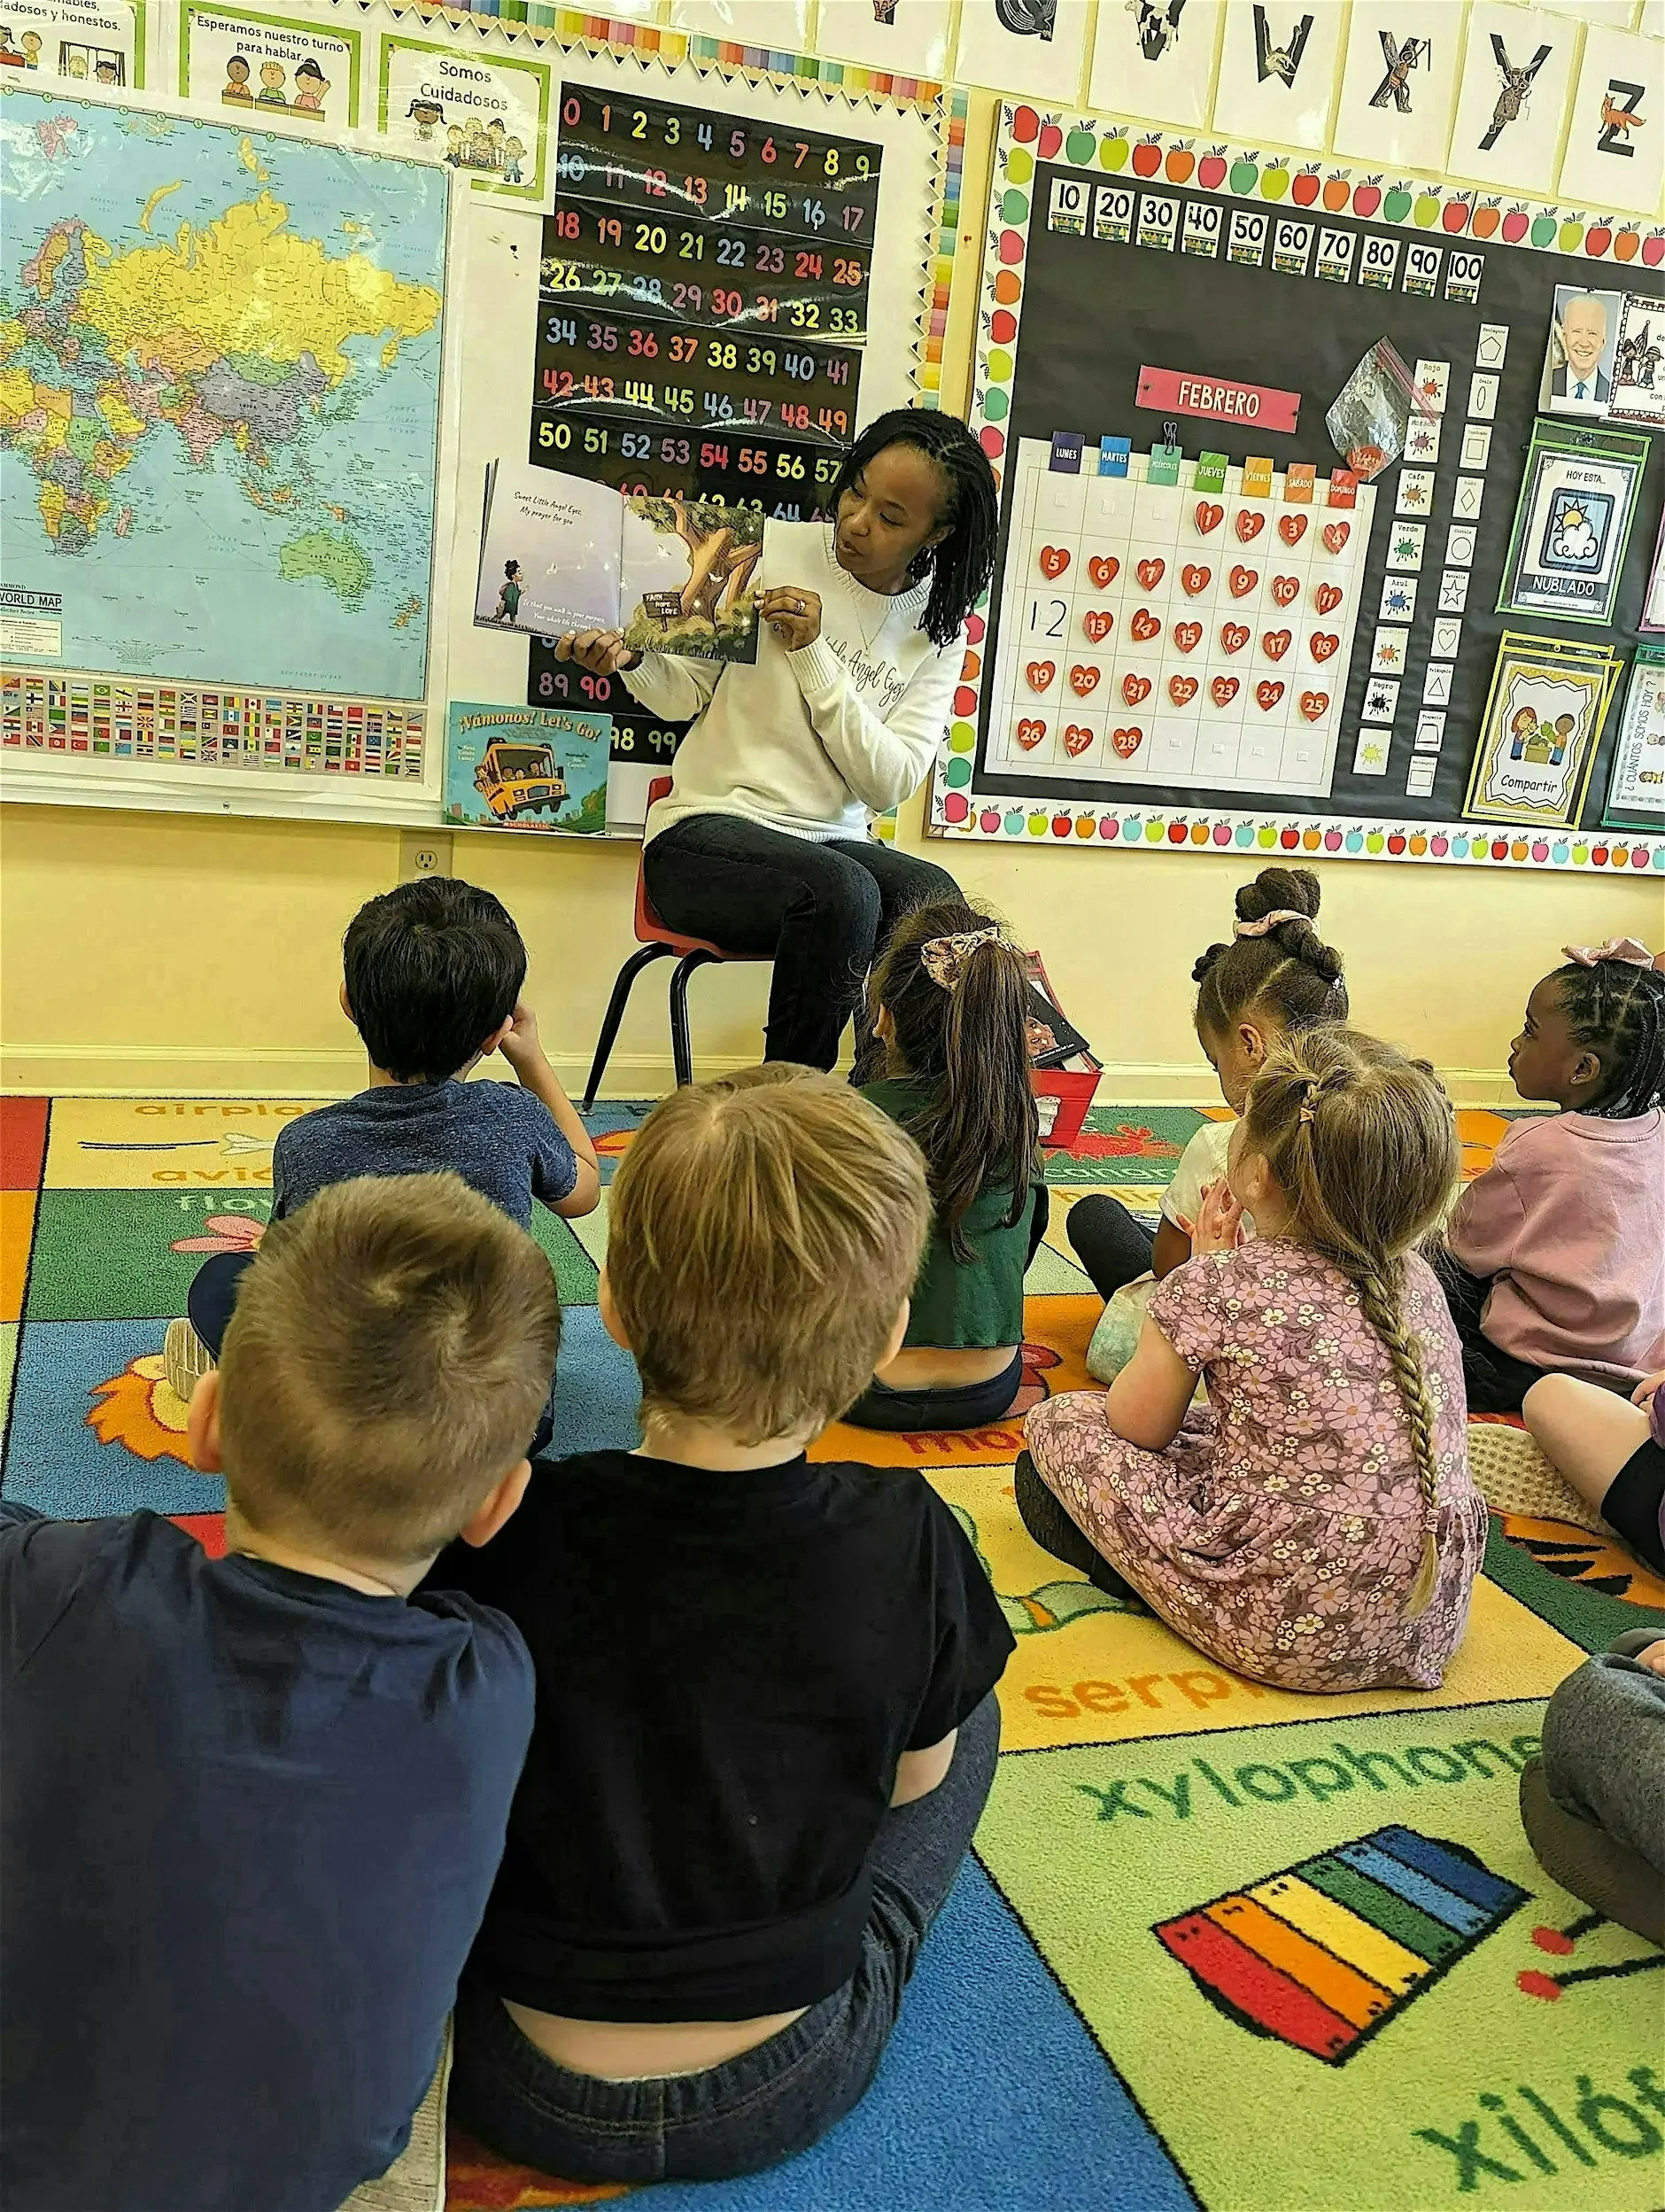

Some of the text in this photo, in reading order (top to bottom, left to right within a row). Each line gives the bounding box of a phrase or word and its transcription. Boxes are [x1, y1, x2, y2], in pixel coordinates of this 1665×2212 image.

[50, 10, 58, 21] y
[62, 10, 120, 30] honestos.
[197, 16, 344, 52] Esperamos nuestro turno
[236, 43, 304, 62] para hablar.
[1253, 4, 1315, 89] W
[439, 61, 492, 82] Somos
[421, 83, 507, 111] Cuidadosos
[1478, 33, 1553, 151] Y
[1597, 79, 1646, 158] Z
[563, 98, 870, 181] 0 1 2 3 4 5 6 7 8 9
[763, 191, 864, 231] 15 16 17
[555, 211, 862, 286] 18 19 20 21 22 23 24 25
[1058, 183, 1483, 282] 10 20 30 40 50 60 70 80 90 100
[672, 283, 858, 333] 29 30 32 33
[546, 318, 848, 385] 34 35 36 37 38 39 40 41
[1424, 363, 1441, 372] Rojo
[664, 386, 848, 435] 45 46 48 49
[1178, 380, 1260, 418] FEBRERO
[538, 422, 842, 484] 50 51 52 53 54 55 56 57
[1055, 447, 1078, 461] LUNES
[1101, 450, 1127, 463] MARTES
[1198, 466, 1225, 478] JUEVES
[1246, 472, 1271, 482] VIERNES
[1330, 485, 1355, 494] DOMINGO
[1566, 470, 1583, 479] HOY
[520, 506, 530, 516] My
[530, 510, 551, 519] prayer
[533, 496, 549, 506] Little
[550, 501, 567, 511] Angel
[1204, 510, 1342, 545] 1 2 3 4
[1049, 555, 1335, 607] 5 6 7 8 9 10 11
[1533, 576, 1594, 596] NUBLADO
[39, 596, 62, 608] MAP
[1030, 600, 1067, 638] 12
[1089, 617, 1332, 655] 13 14 15 16 17 18
[538, 672, 610, 701] 89 90
[848, 649, 885, 693] Angel
[1373, 681, 1393, 690] Negro
[1032, 669, 1324, 714] 19 20 21 22 23 24 25
[459, 710, 537, 734] ¡Vámonos!
[540, 711, 573, 732] Let's
[576, 721, 602, 742] Go!
[610, 726, 677, 754] 98 99
[1020, 726, 1138, 749] 26 27 28
[1500, 774, 1558, 795] Compartir
[135, 1103, 306, 1117] airpla
[1045, 1168, 1177, 1179] cangr
[1412, 2065, 1665, 2193] xilóf
